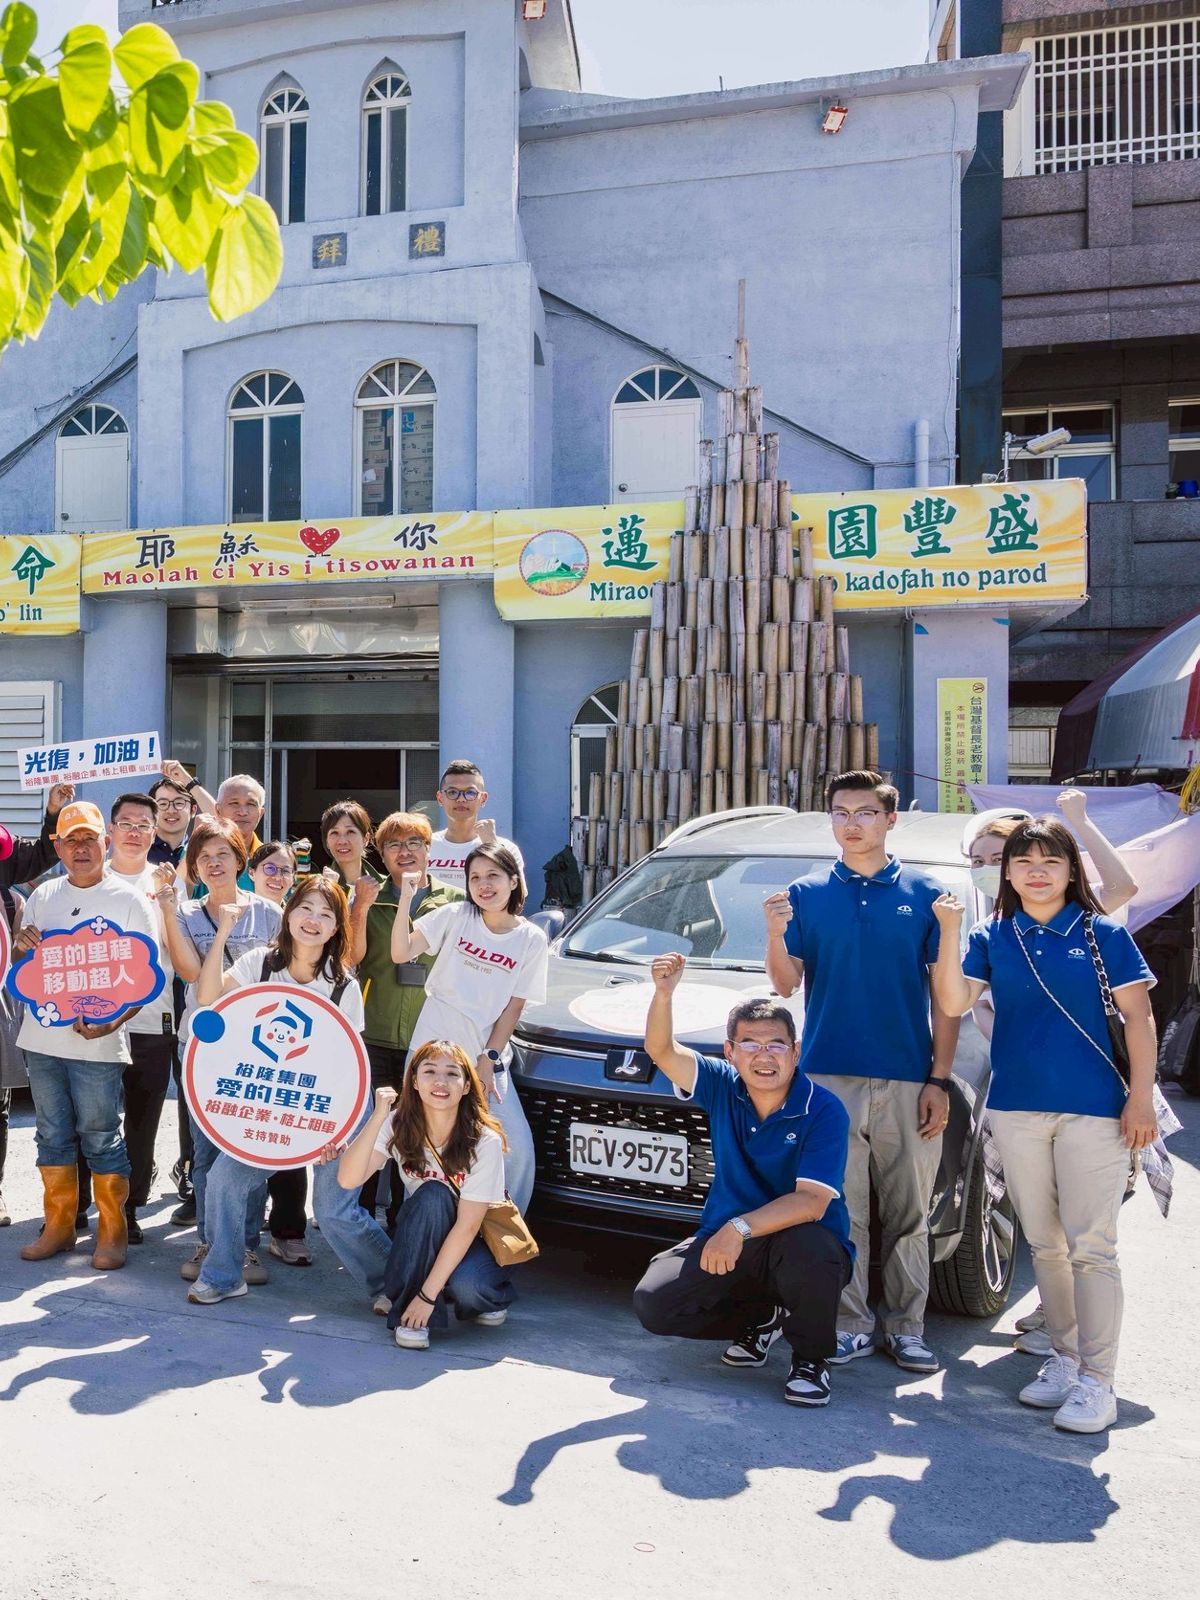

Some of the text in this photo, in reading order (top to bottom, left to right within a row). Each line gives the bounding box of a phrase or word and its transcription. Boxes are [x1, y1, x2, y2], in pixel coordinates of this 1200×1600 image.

[414, 225, 441, 254] 禮
[393, 522, 440, 551] 你
[103, 554, 476, 587] Maolah ci Yis i tisowanan
[590, 582, 654, 602] Mirao
[845, 568, 935, 595] kadofah
[941, 570, 971, 588] no
[978, 563, 1047, 592] parod
[19, 603, 43, 622] lin
[41, 938, 134, 970] 愛的里程
[458, 936, 517, 970] YULON
[43, 964, 135, 995] 移動超人
[234, 1062, 317, 1089] 裕隆集團
[215, 1077, 332, 1114] 愛的里程
